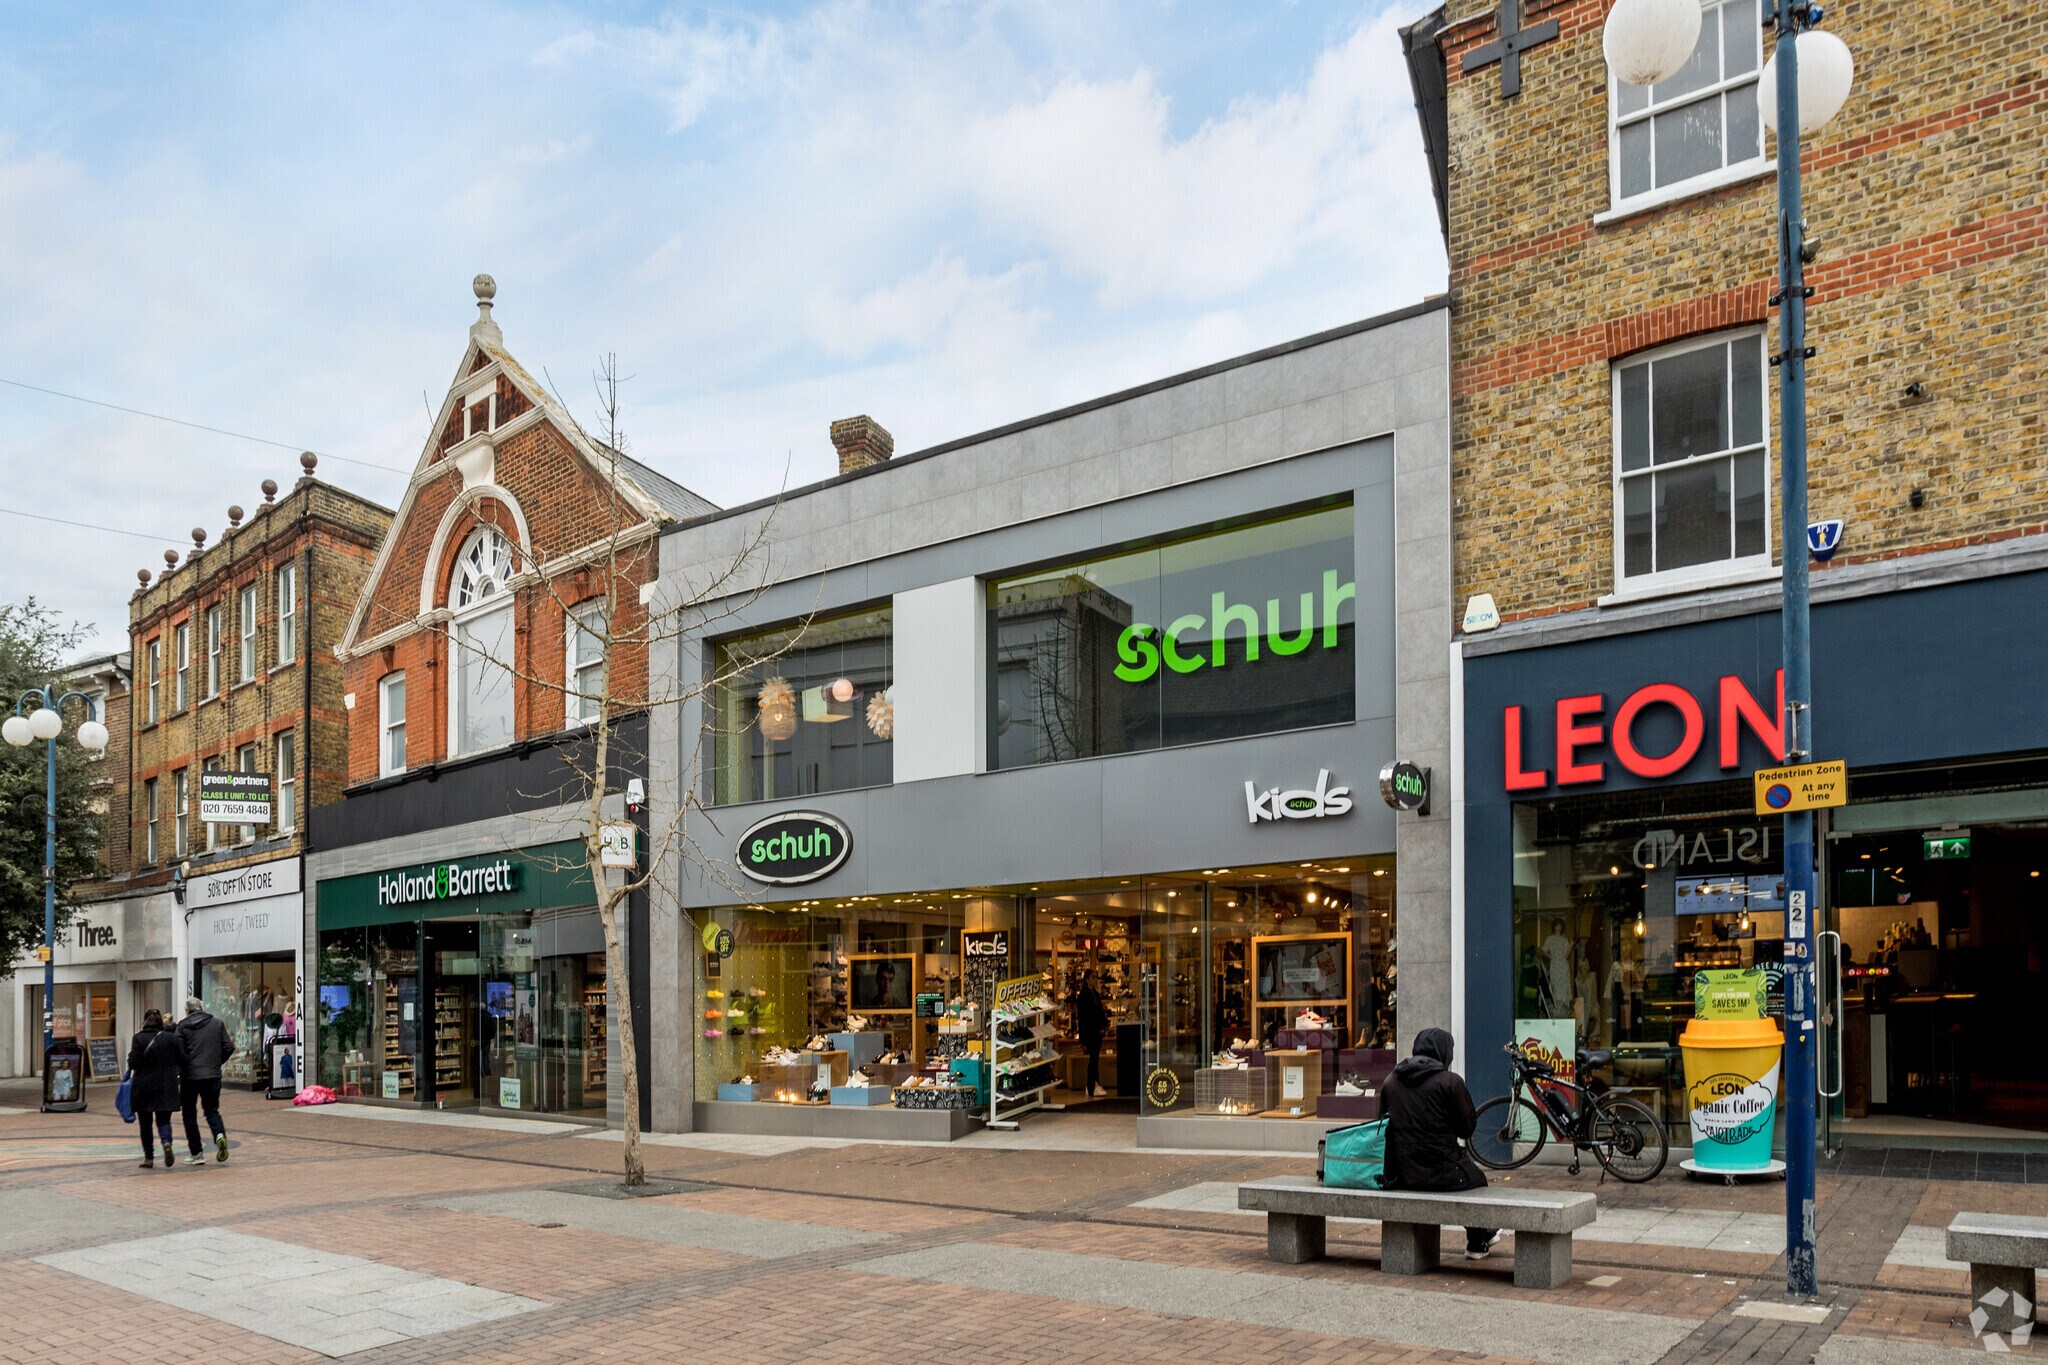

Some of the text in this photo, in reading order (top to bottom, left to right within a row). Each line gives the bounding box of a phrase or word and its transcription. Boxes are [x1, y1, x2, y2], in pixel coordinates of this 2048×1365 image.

[1113, 568, 1356, 683] schuh
[1504, 668, 1785, 793] LEON
[202, 774, 269, 786] green&partners
[1759, 765, 1841, 781] Pedestrian Zone
[1395, 771, 1422, 796] schuh
[1802, 782, 1835, 792] At any
[202, 791, 223, 799] CLASS
[230, 792, 244, 800] UNIT
[1245, 768, 1352, 823] kids
[1289, 799, 1316, 809] schuh
[1807, 793, 1830, 802] time
[203, 803, 268, 815] 020 7659 4848
[751, 827, 831, 863] schuh
[207, 871, 272, 898] 50% OFF IN STORE
[378, 859, 511, 906] Holland&Barrett
[1793, 892, 1802, 905] 2
[1792, 907, 1802, 921] 2
[213, 917, 235, 934] HOUSE
[245, 912, 270, 930] TWEED
[998, 978, 1040, 1002] OFFERS
[1712, 999, 1737, 1008] SAVES
[1711, 1082, 1745, 1096] LEON
[1694, 1096, 1765, 1116] Organic Coffee
[1706, 1125, 1753, 1143] FAIRTRADE
